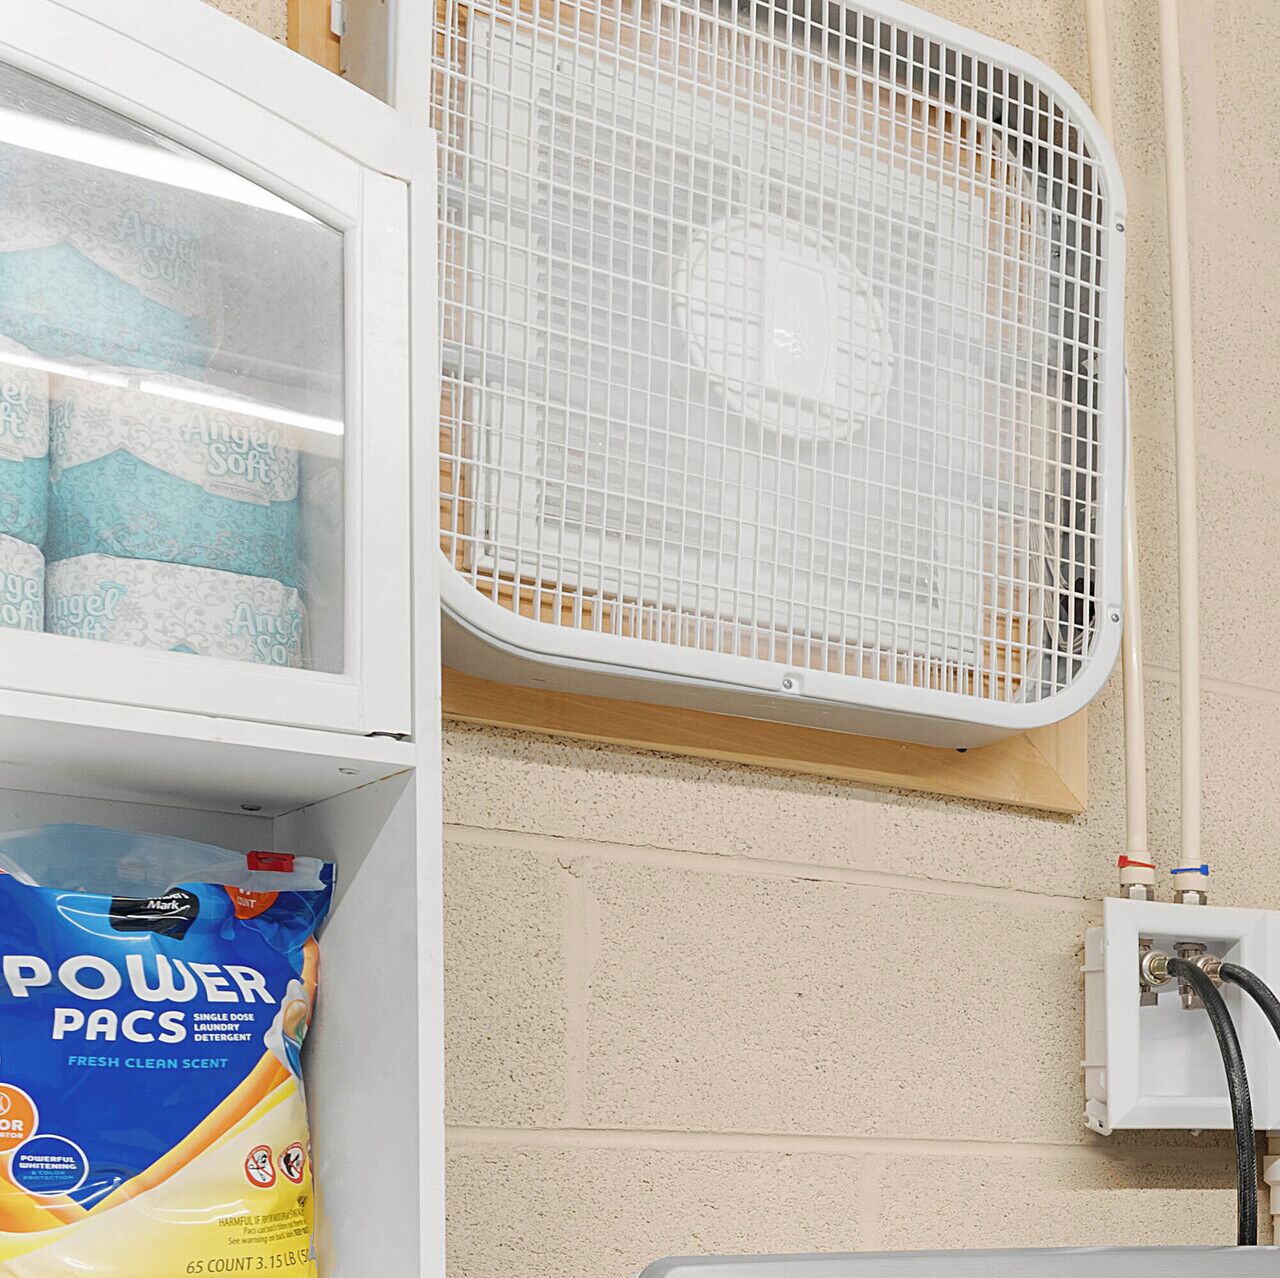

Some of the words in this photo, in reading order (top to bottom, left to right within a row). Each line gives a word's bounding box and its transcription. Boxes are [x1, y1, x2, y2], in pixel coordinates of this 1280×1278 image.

[180, 410, 278, 460] Angel
[207, 442, 271, 484] Soft
[147, 900, 179, 910] Mark
[3, 954, 276, 1004] POWER
[193, 1013, 229, 1022] SINGLE
[230, 1013, 255, 1022] DOSE
[52, 1007, 187, 1043] PACS
[194, 1023, 240, 1032] LAUNDRY
[194, 1033, 252, 1042] DETERGENT
[68, 1055, 120, 1067] FRESH
[124, 1057, 180, 1069] CLEAN
[182, 1058, 228, 1069] SCENT
[20, 1155, 76, 1163] POWERFUL
[19, 1162, 77, 1170] WHITENING
[218, 1216, 254, 1227] HARMFUL
[228, 1237, 240, 1246] See
[186, 1260, 204, 1274] 65
[207, 1256, 253, 1273] COUNT
[256, 1254, 282, 1270] 3.15
[285, 1251, 296, 1267] LB
